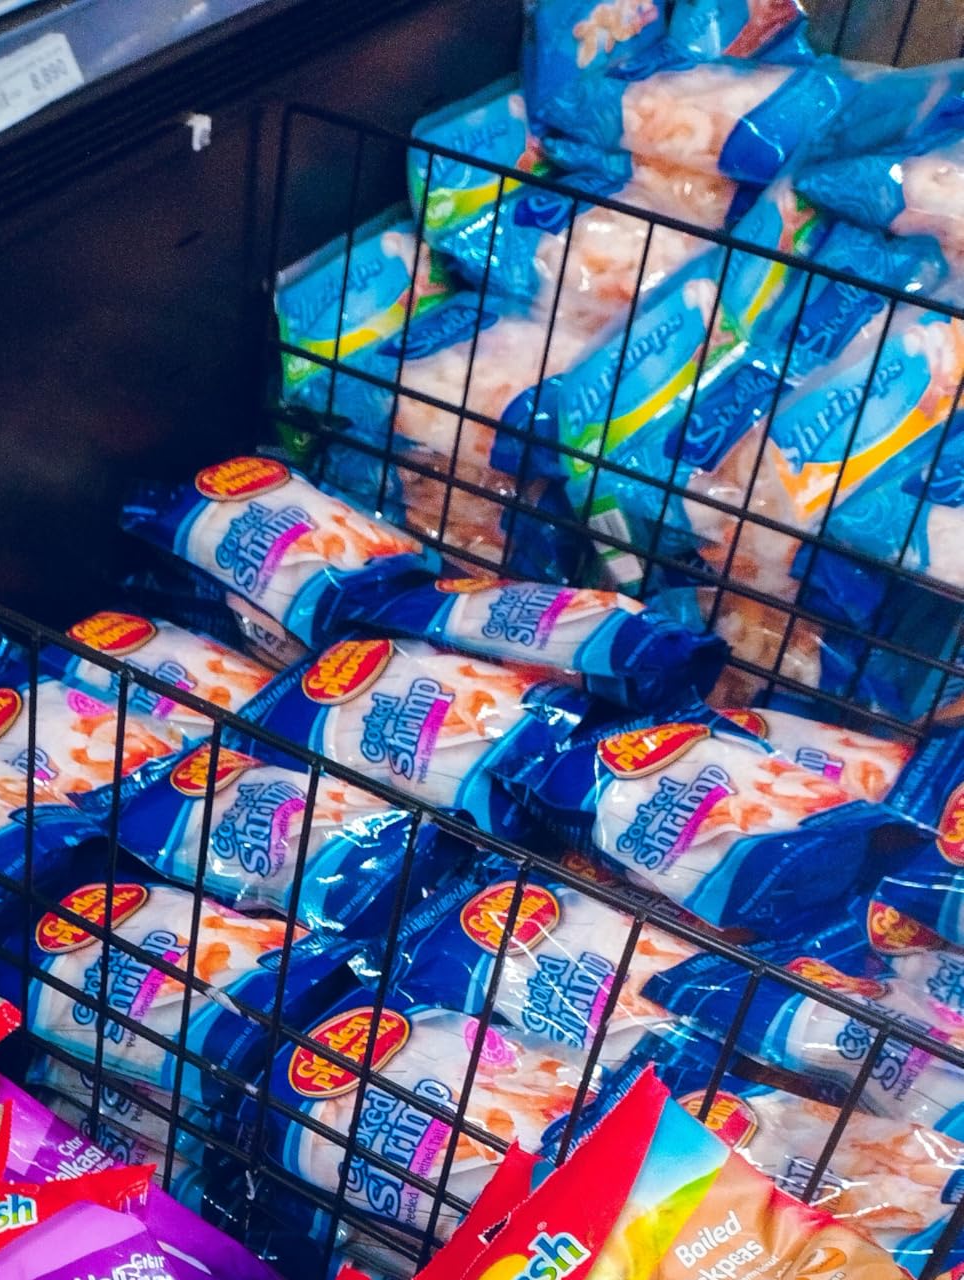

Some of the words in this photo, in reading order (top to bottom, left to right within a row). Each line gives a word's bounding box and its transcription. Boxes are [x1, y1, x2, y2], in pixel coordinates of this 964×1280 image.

[234, 506, 318, 593] Shrimp
[360, 691, 401, 763] Cooked
[388, 677, 455, 780] Shrimp
[235, 781, 307, 878] Shrimp
[616, 776, 687, 856] Cooked
[634, 765, 737, 870] Shrimp
[46, 1145, 105, 1182] alkası
[58, 1135, 84, 1159] Çıtır
[131, 1253, 165, 1274] Çıtır
[674, 1210, 742, 1269] Boiled
